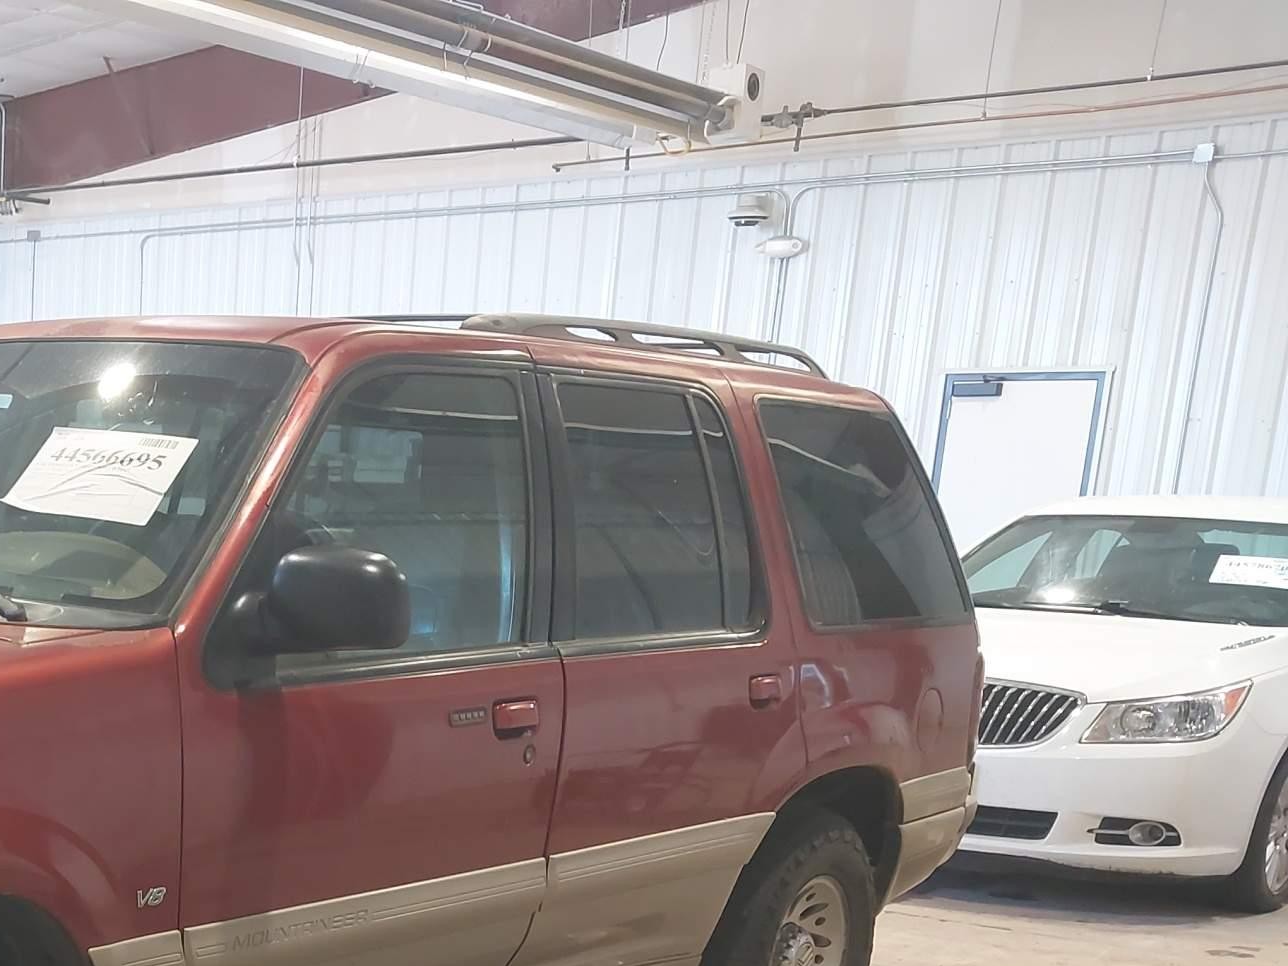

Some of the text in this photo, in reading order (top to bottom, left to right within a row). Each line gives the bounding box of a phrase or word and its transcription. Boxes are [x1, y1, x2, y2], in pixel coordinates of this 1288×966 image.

[50, 447, 167, 471] 44566695
[137, 887, 167, 908] V8
[232, 909, 369, 951] MOUNTAINEER
